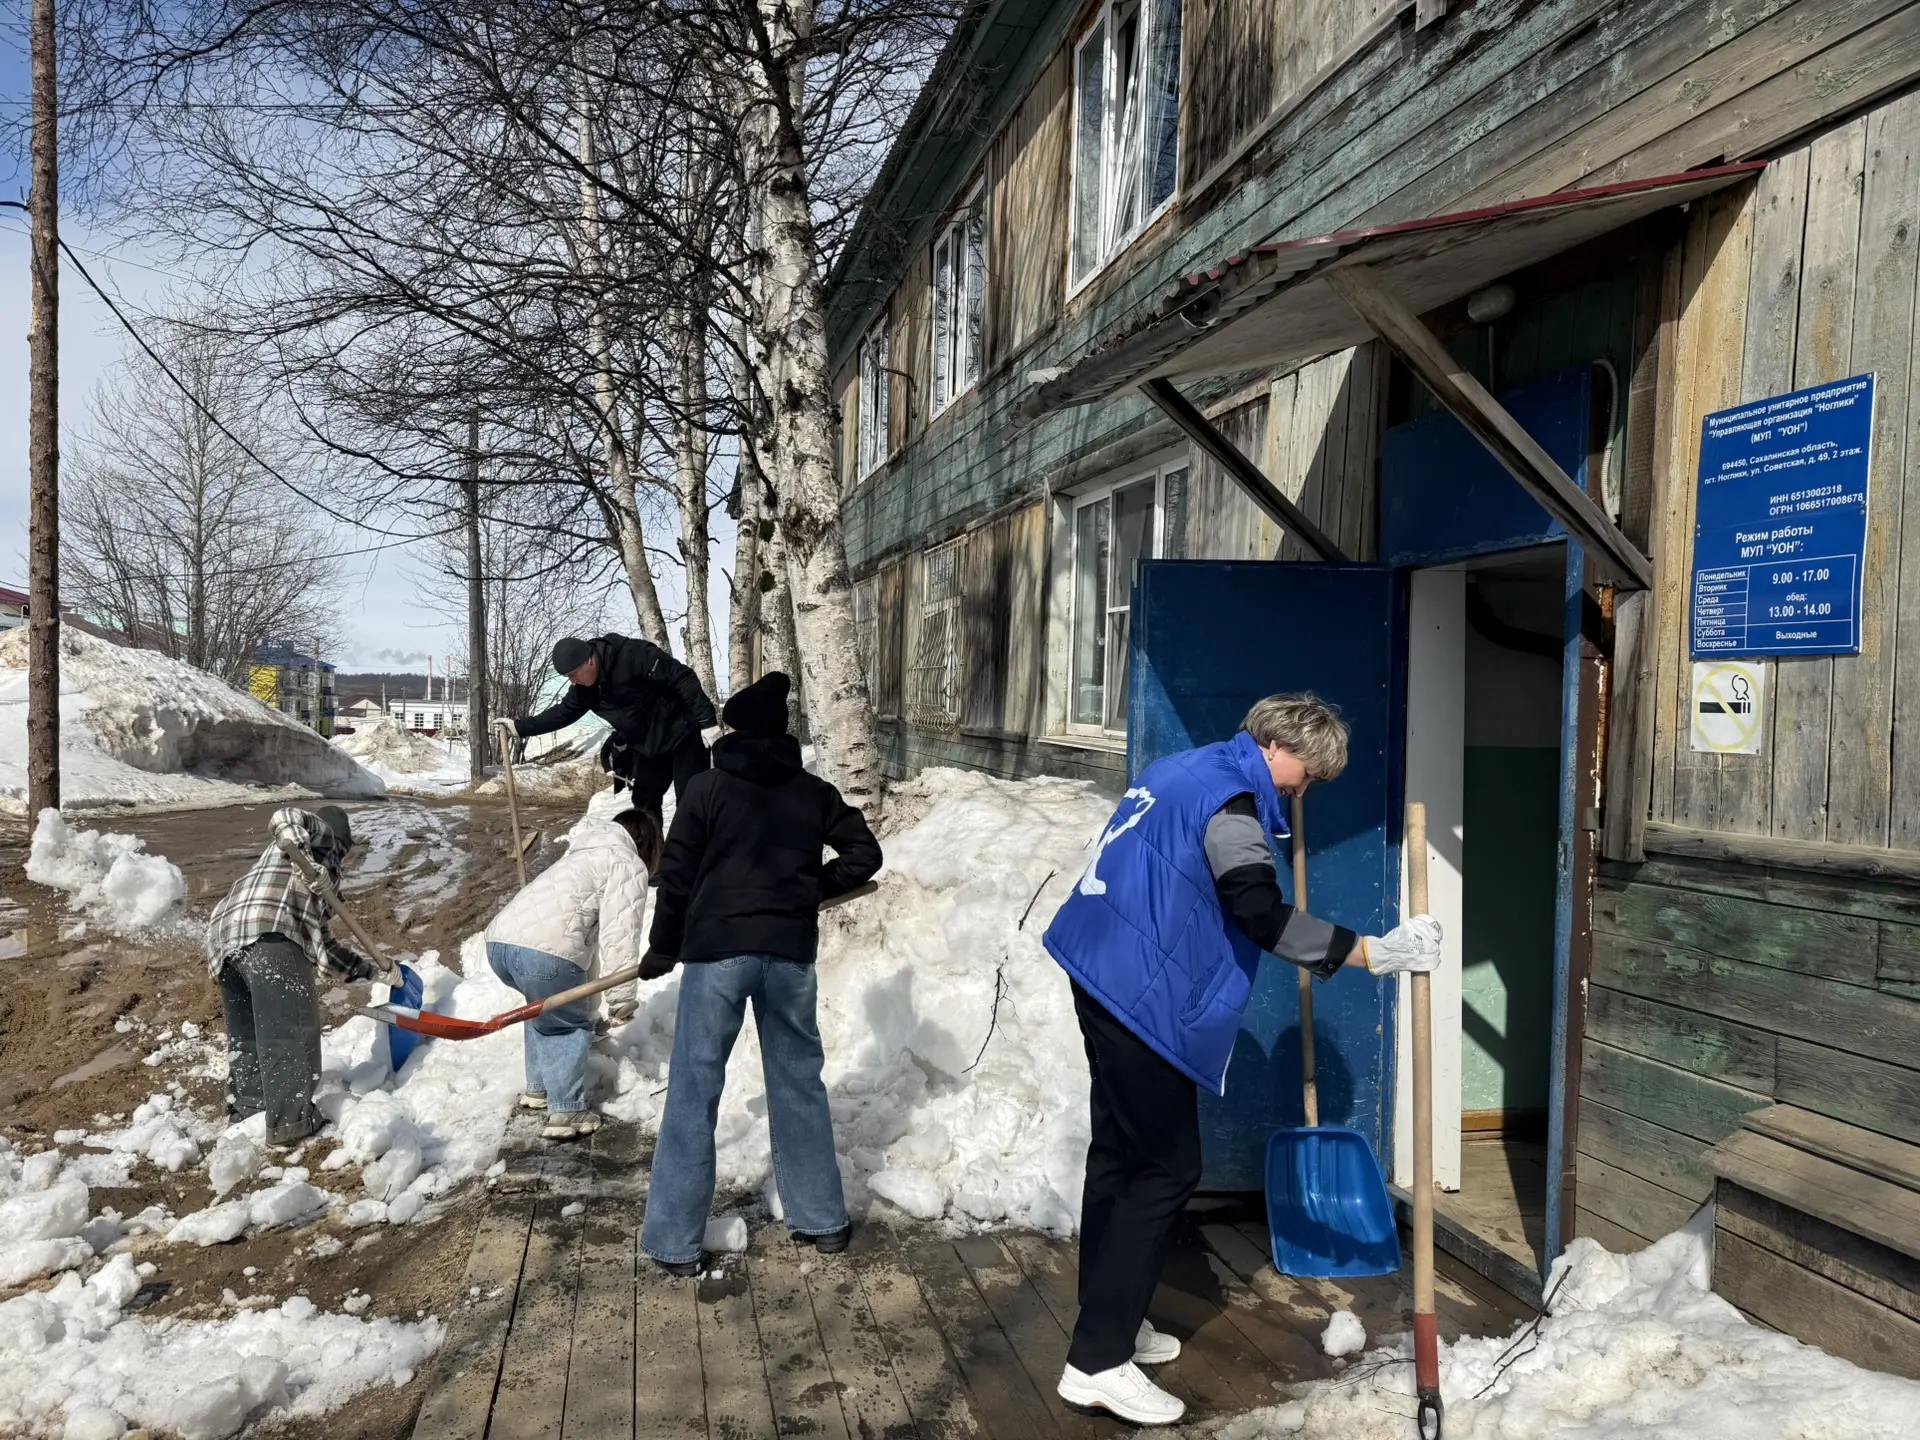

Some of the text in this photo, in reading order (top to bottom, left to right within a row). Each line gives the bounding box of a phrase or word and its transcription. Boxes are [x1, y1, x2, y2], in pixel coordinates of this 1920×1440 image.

[1710, 381, 1867, 428] Муниципальное унитарное предприятие
[1763, 407, 1813, 427] организация
[1751, 430, 1772, 444] (МУП
[1722, 440, 1838, 470] 694450, Сахалинская область,
[1704, 447, 1863, 485] пгт. Ноглики, ул. Советская, д. 49, 2 этаж.
[1770, 484, 1842, 504] ИНН 6513002318
[1769, 493, 1864, 515] ОГРН 1066517008678
[1736, 526, 1813, 543] Режим работы
[1741, 545, 1763, 558] МУП
[1700, 571, 1746, 581] Понедельник
[1772, 572, 1792, 584] 9.00
[1802, 568, 1829, 582] 17.00
[1699, 583, 1727, 592] Вторник
[1698, 596, 1719, 605] Среда
[1786, 593, 1807, 601] обед:
[1698, 607, 1724, 616] Четверг
[1769, 606, 1794, 618] 13.00
[1804, 603, 1831, 615] 14.00
[1697, 618, 1725, 627] Пятница
[1697, 628, 1725, 637] Суббота
[1776, 631, 1817, 640] Выходные
